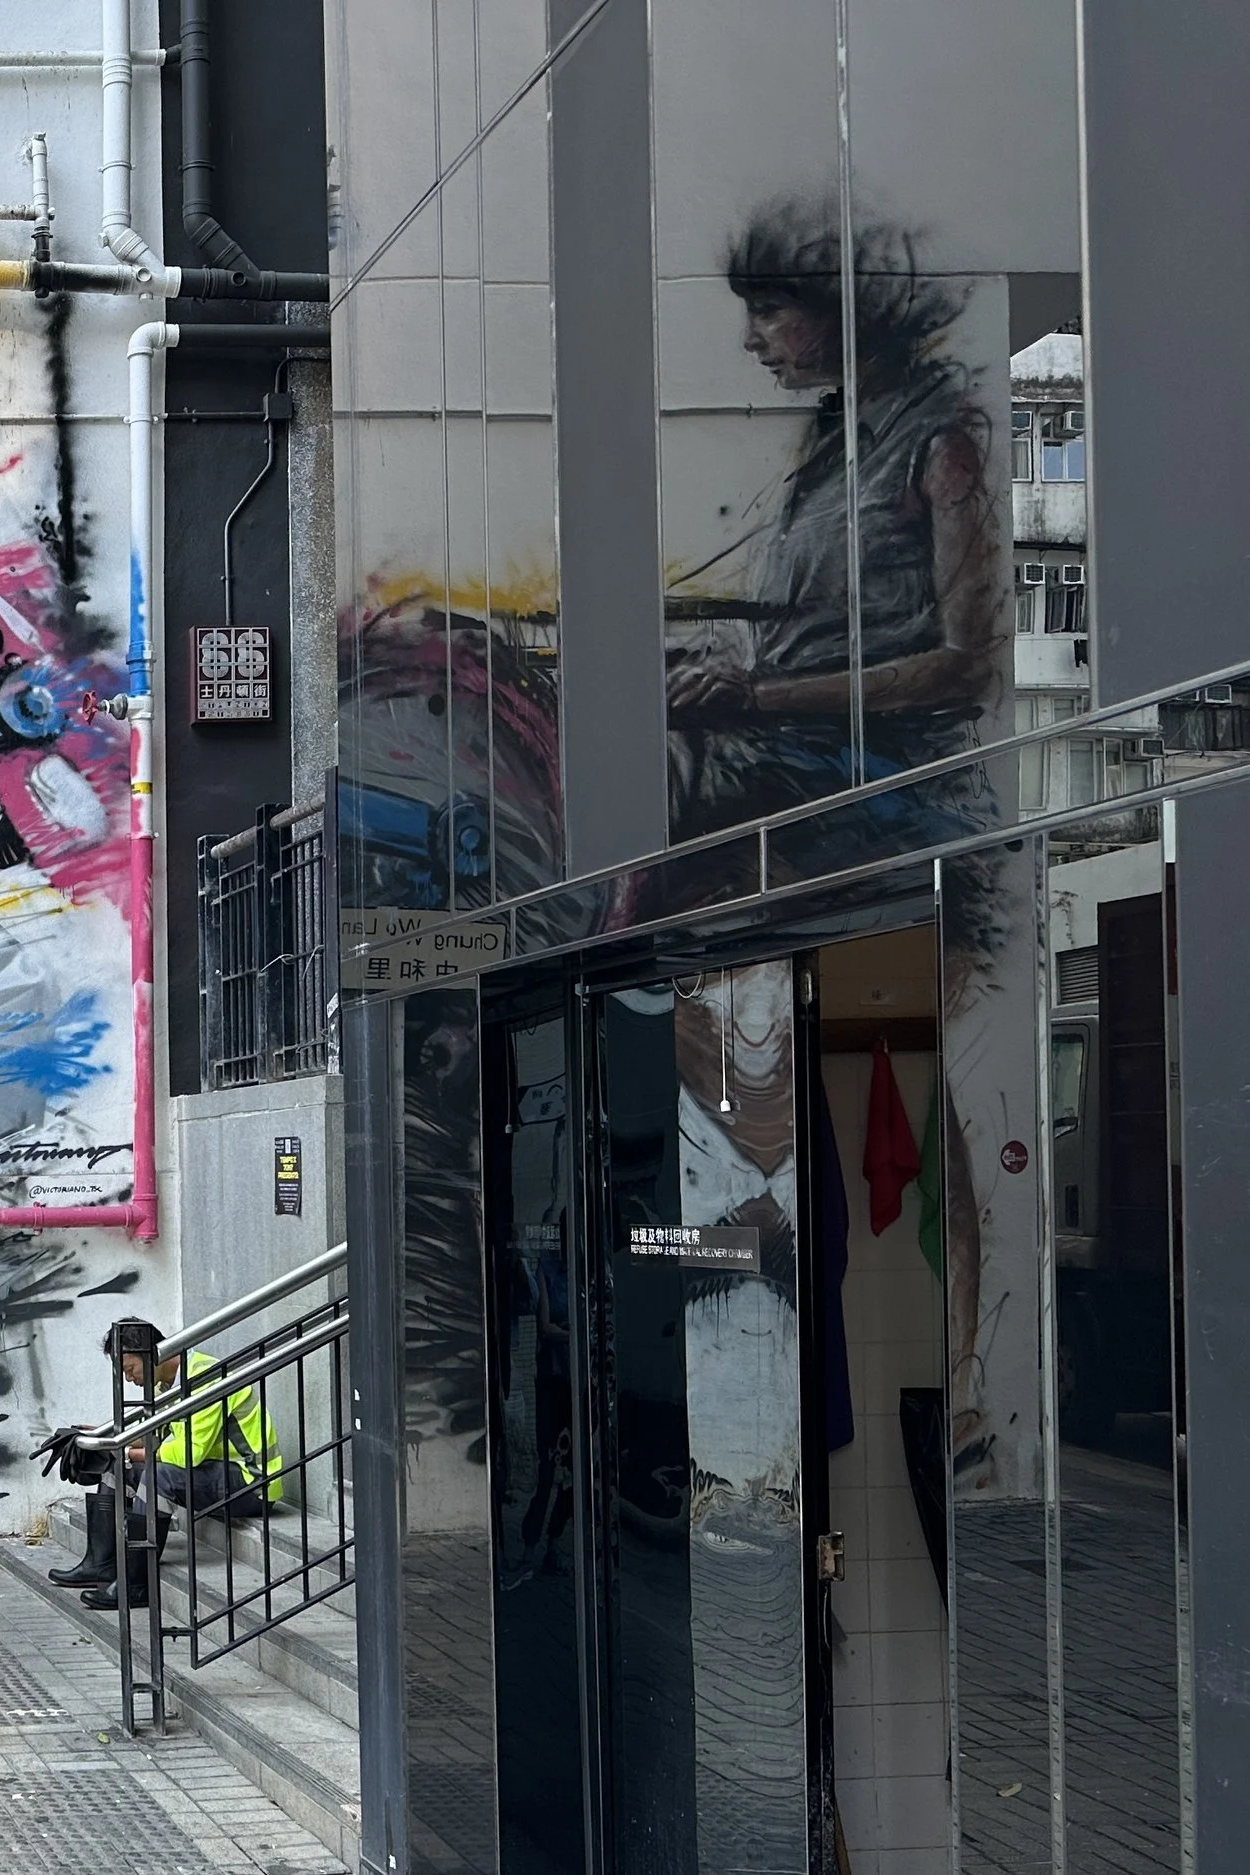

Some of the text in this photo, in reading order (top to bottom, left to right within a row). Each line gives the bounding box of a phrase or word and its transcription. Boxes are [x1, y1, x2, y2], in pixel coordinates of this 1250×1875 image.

[631, 1227, 700, 1245] 垃圾及物料回收房
